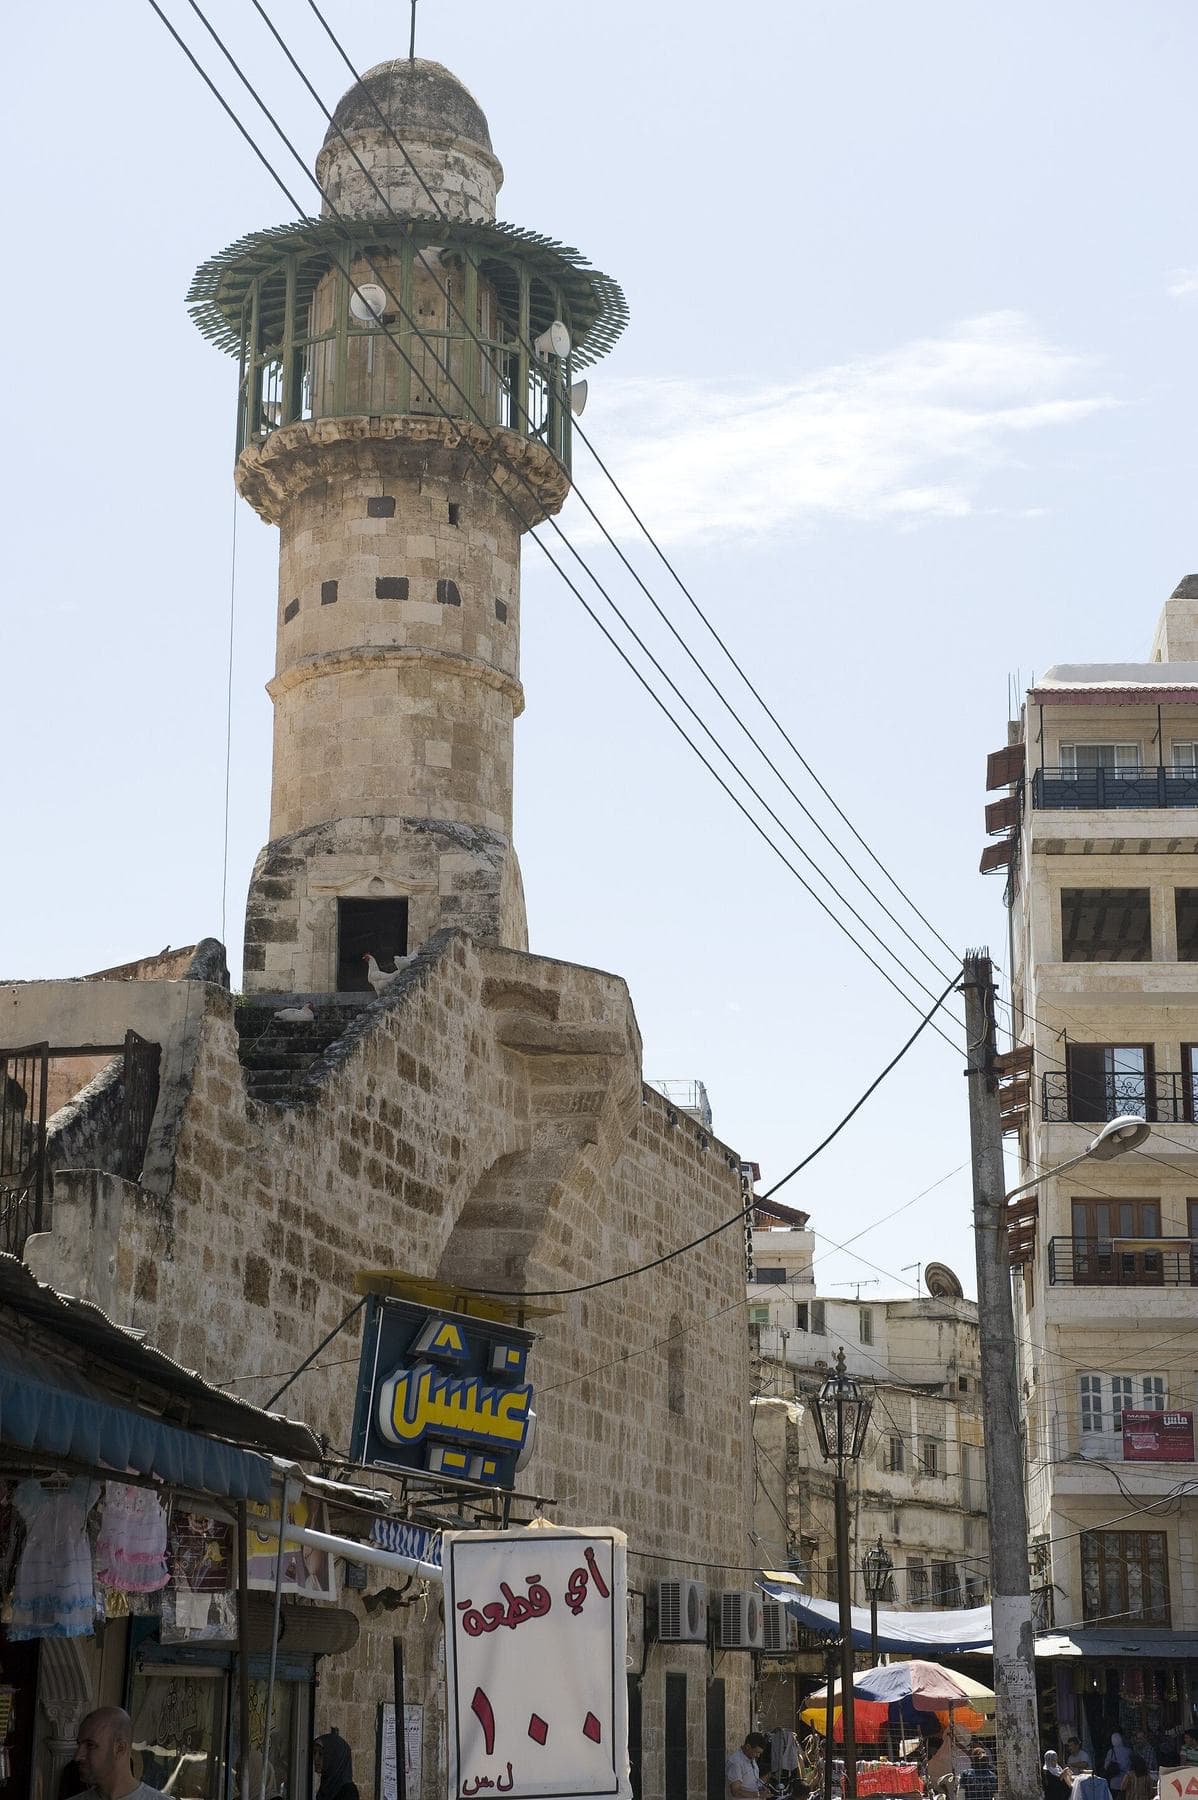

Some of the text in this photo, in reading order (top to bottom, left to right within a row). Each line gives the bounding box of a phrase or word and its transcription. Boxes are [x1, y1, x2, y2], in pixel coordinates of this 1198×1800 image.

[456, 1547, 610, 1637] أي قطعة
[471, 1687, 601, 1755] ١٠٠
